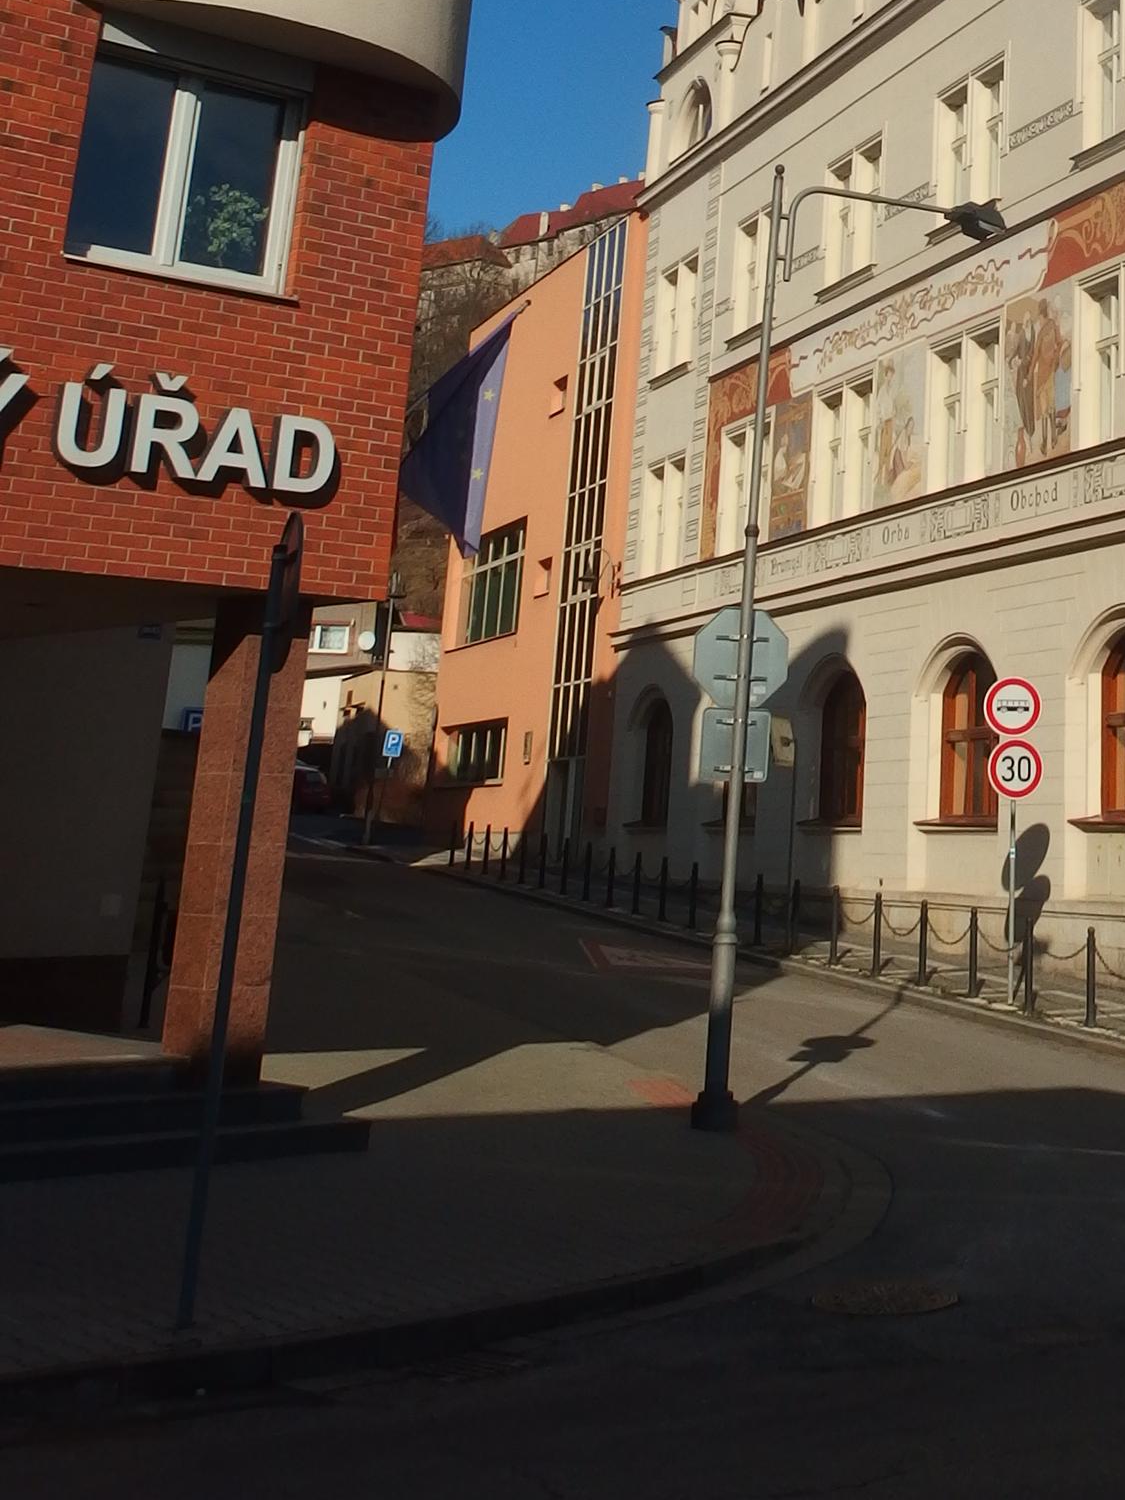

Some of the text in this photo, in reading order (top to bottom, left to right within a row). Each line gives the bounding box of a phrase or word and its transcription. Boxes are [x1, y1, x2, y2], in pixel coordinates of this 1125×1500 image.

[57, 363, 337, 494] ÚŘAD
[387, 734, 400, 748] P
[1001, 755, 1031, 782] 30
